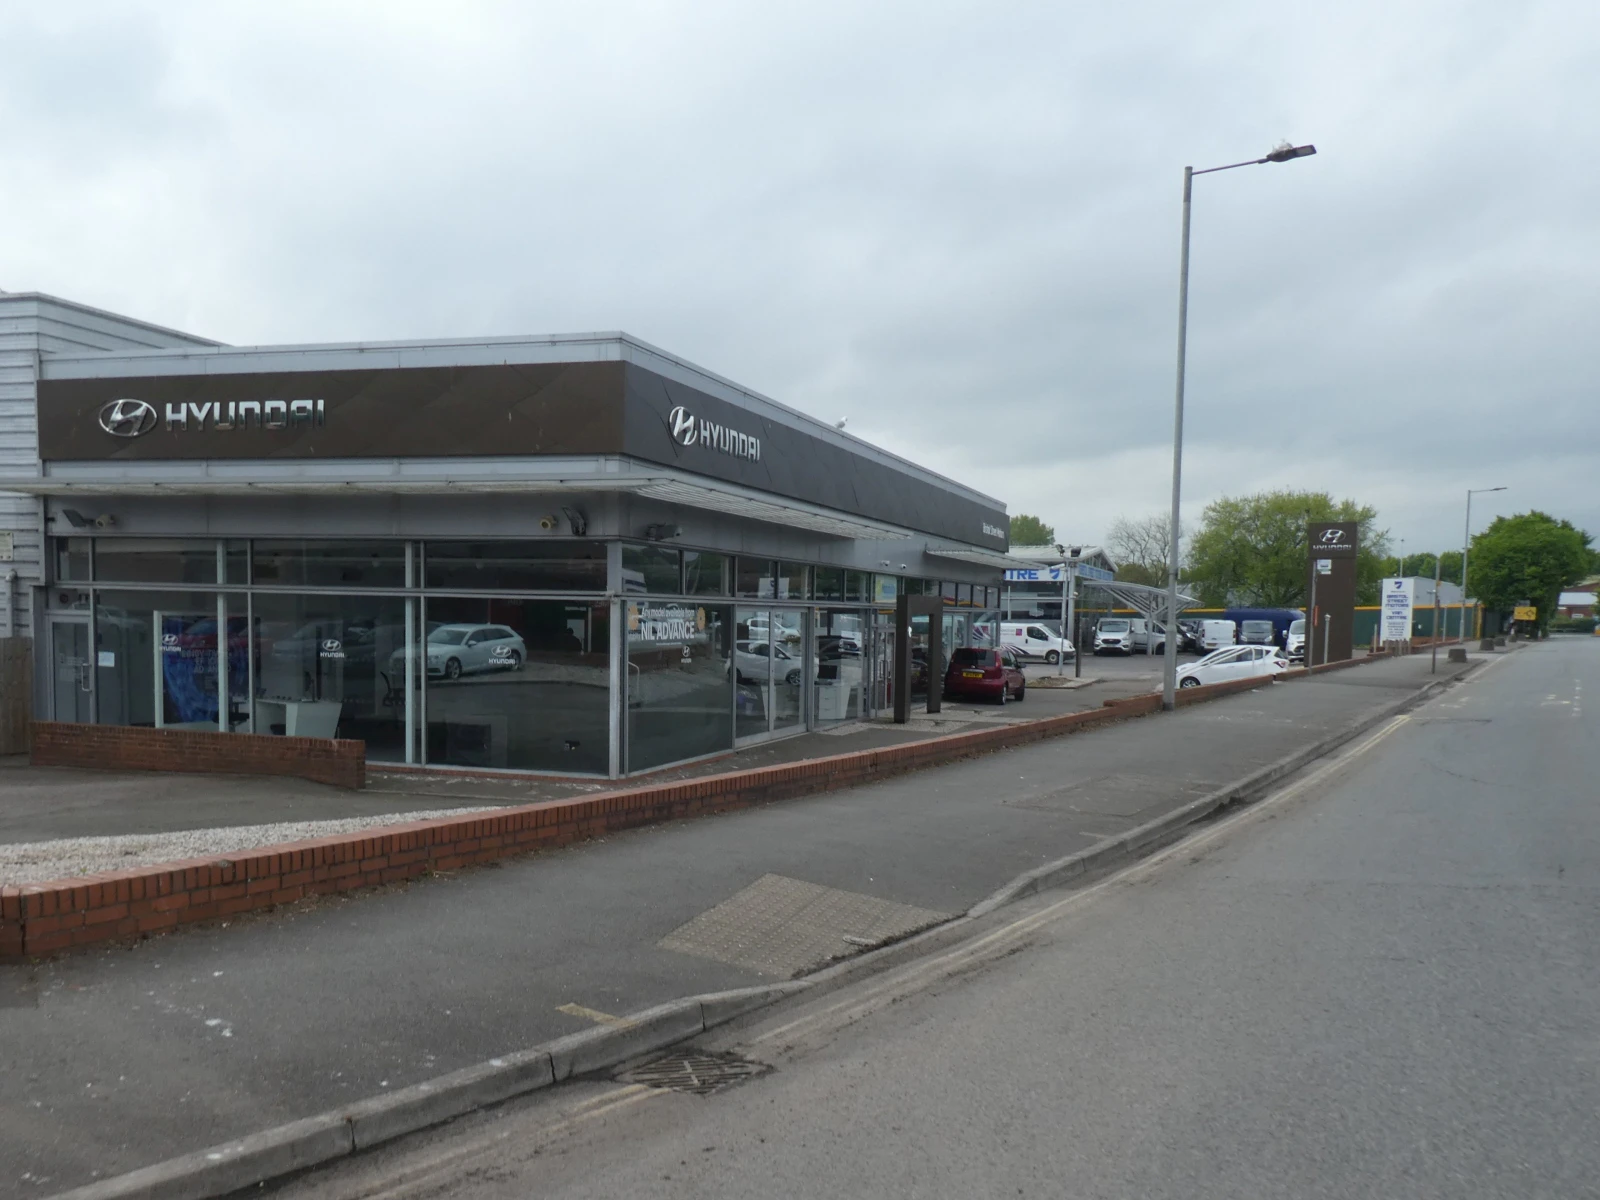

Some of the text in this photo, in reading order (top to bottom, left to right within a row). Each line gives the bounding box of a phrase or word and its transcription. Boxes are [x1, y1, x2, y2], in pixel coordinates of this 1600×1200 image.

[165, 399, 324, 431] HYUNDAI
[700, 418, 760, 461] HYUNDAI
[641, 621, 695, 640] NIL ADVANCE
